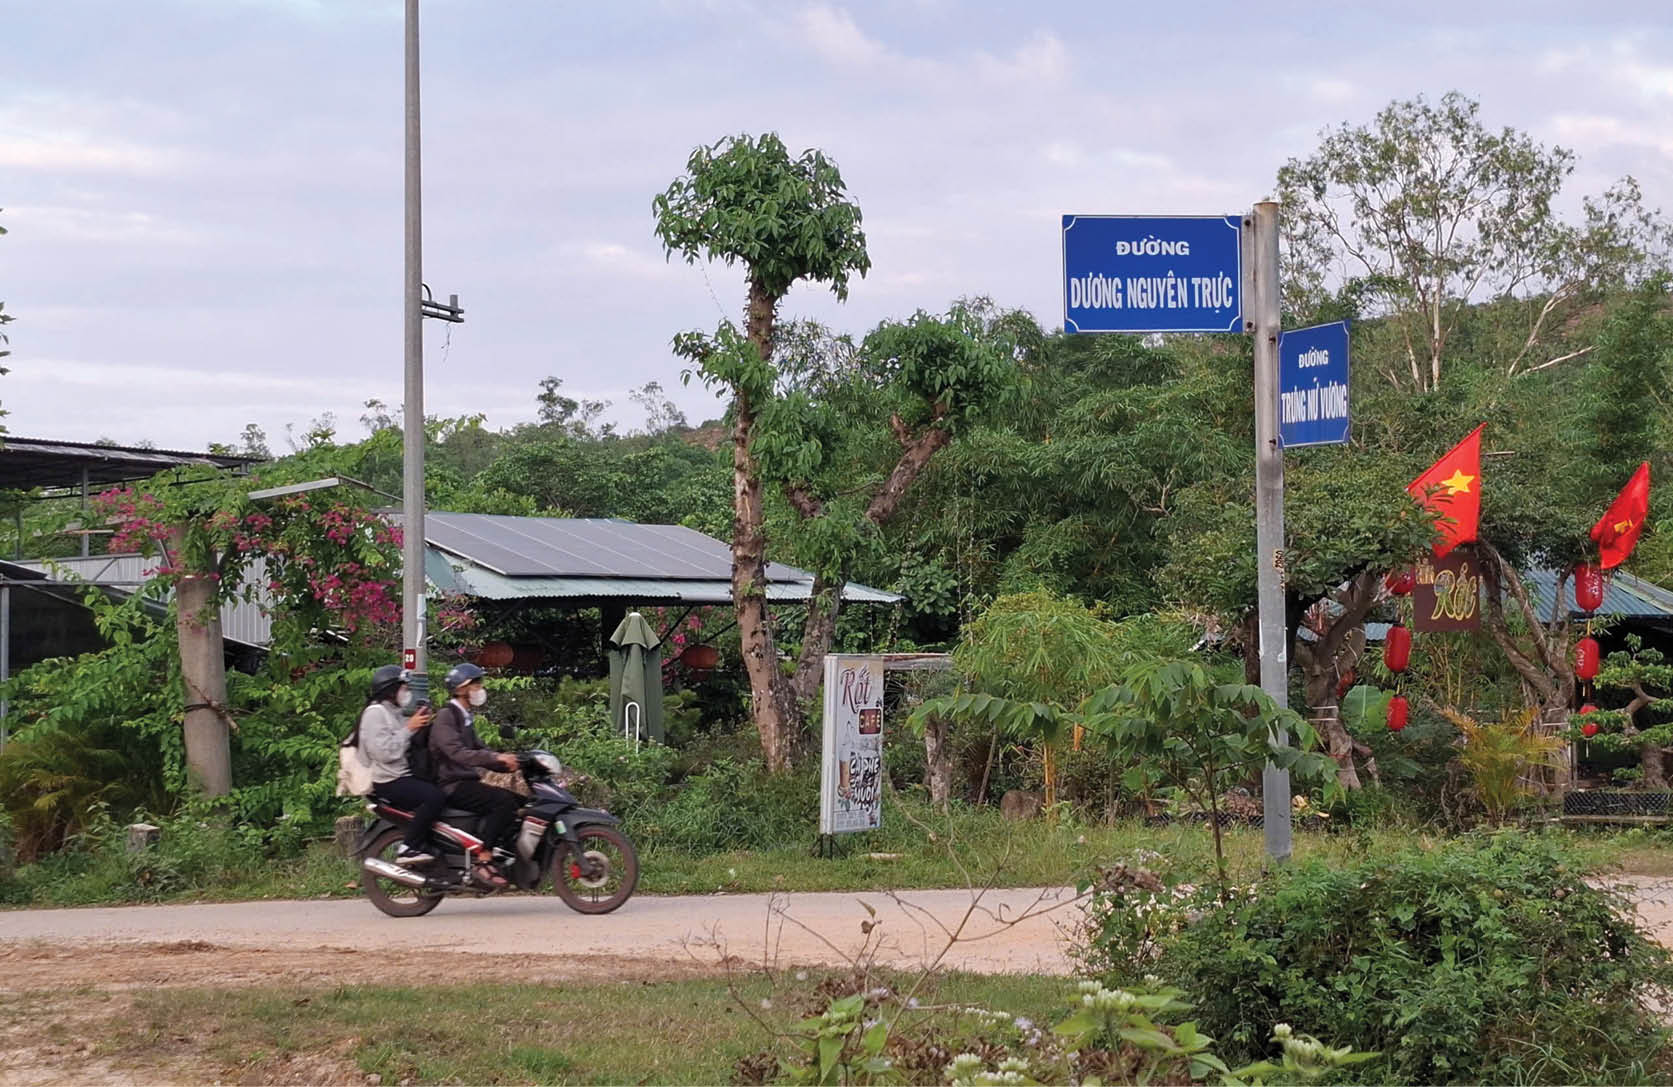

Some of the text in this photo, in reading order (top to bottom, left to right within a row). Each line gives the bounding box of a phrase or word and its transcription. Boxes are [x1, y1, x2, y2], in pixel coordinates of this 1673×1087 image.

[1116, 235, 1190, 256] ĐƯỜNG
[1070, 270, 1233, 314] DƯƠNG NGUYÊN TRỰC
[1298, 346, 1329, 369] ĐƯỜNG
[1281, 385, 1306, 424] TRƯNG
[1320, 380, 1347, 420] VƯƠNG
[405, 654, 414, 663] 20
